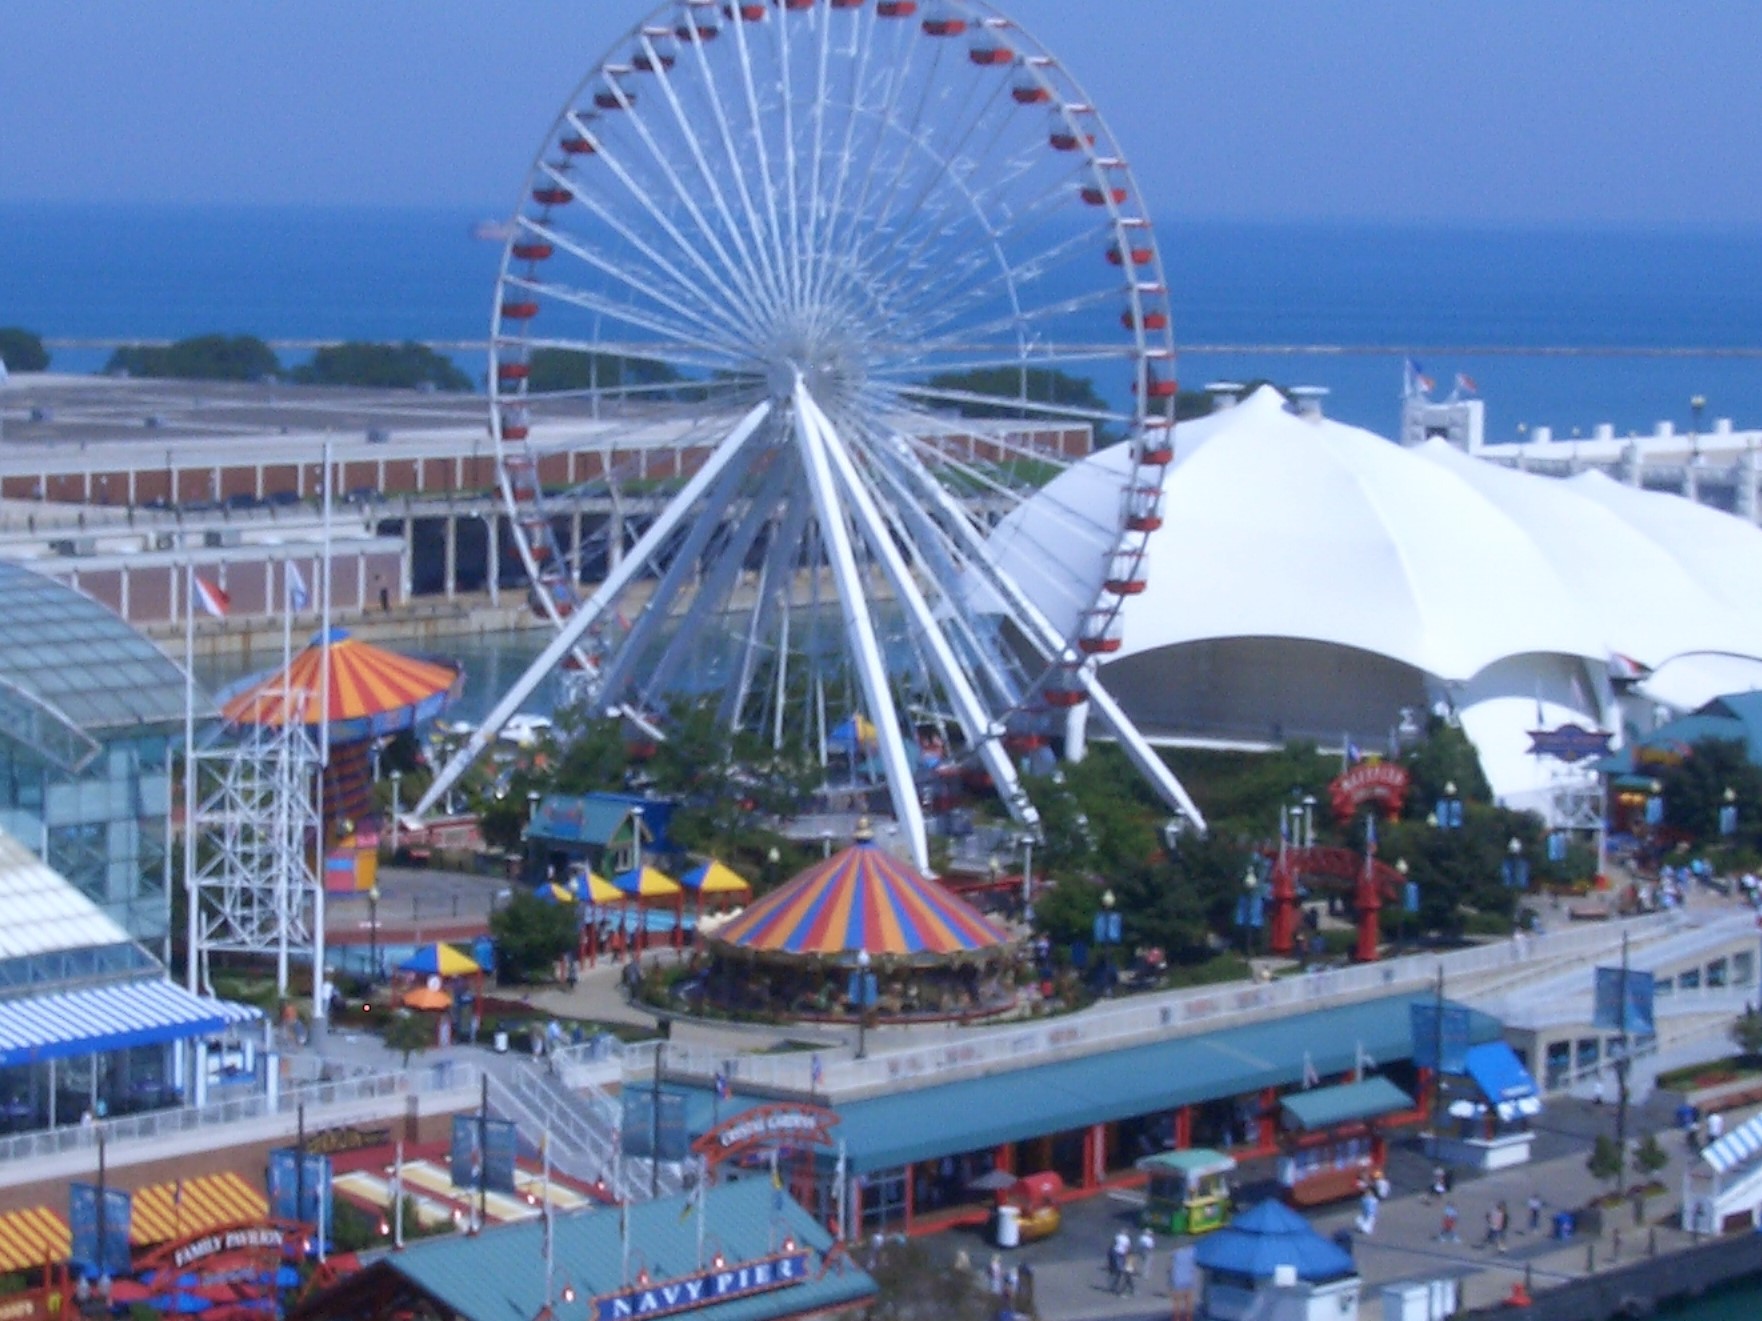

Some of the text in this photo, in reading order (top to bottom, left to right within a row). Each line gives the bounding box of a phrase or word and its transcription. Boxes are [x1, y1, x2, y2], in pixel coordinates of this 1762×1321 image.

[174, 1227, 284, 1268] FAMILY PAVILION
[612, 1258, 794, 1319] NAVY PIER
